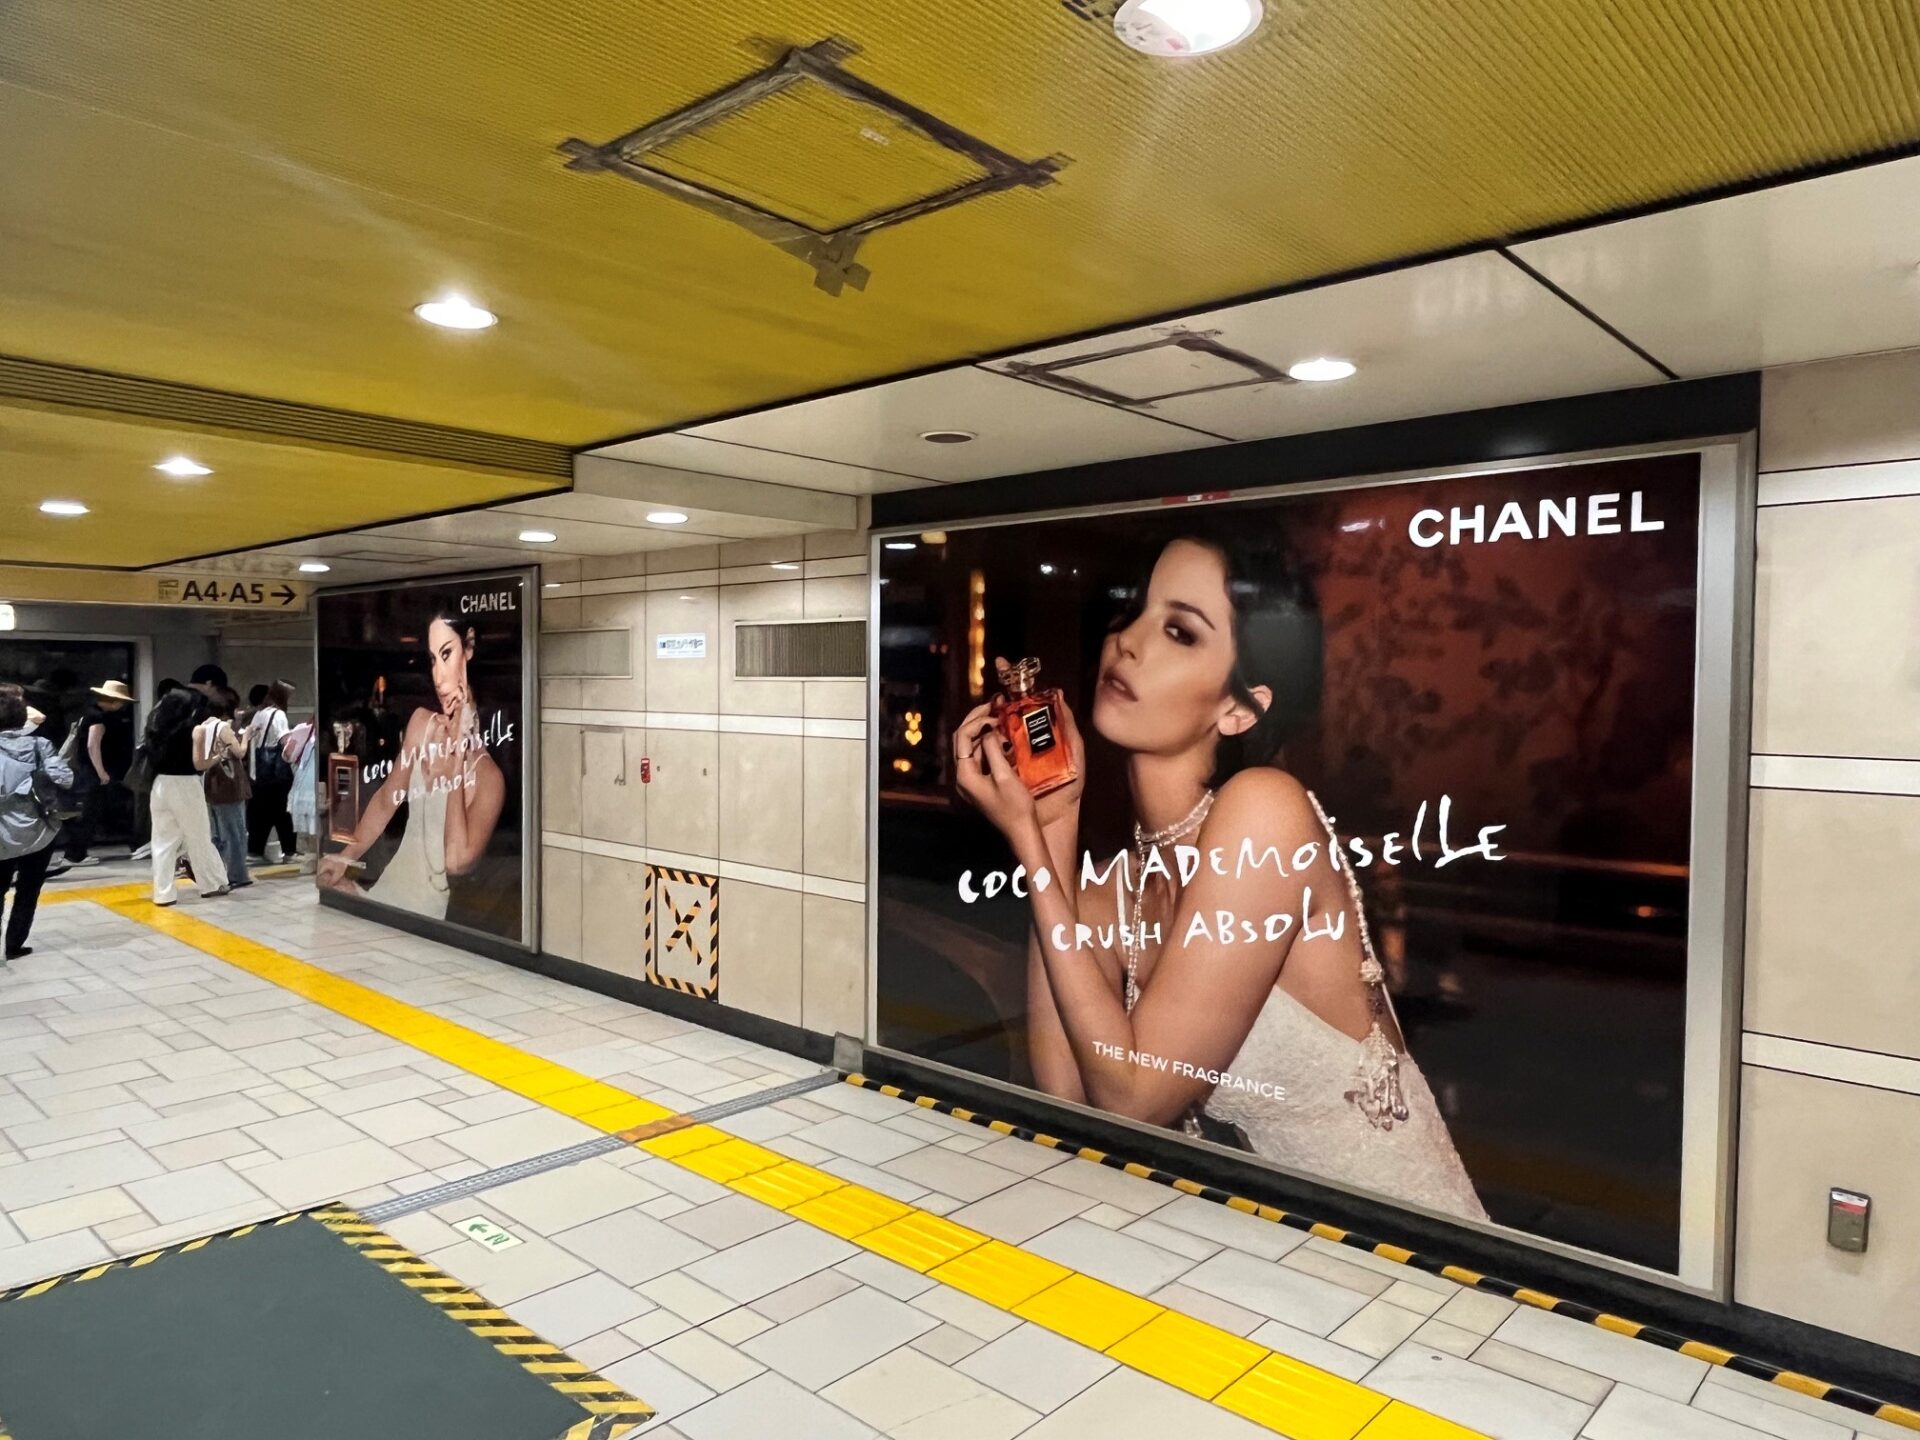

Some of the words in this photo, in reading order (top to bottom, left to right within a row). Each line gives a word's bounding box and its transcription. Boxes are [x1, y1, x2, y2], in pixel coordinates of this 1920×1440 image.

[1408, 491, 1665, 548] CHANEL
[460, 591, 516, 614] CHANEL
[958, 863, 1051, 903] COCO
[1051, 920, 1162, 952] CRUSH
[1183, 886, 1345, 948] ABSOLU
[1092, 1041, 1124, 1061] THE
[1128, 1050, 1168, 1072] NEW
[1172, 1060, 1286, 1101] FRAGRANCE
